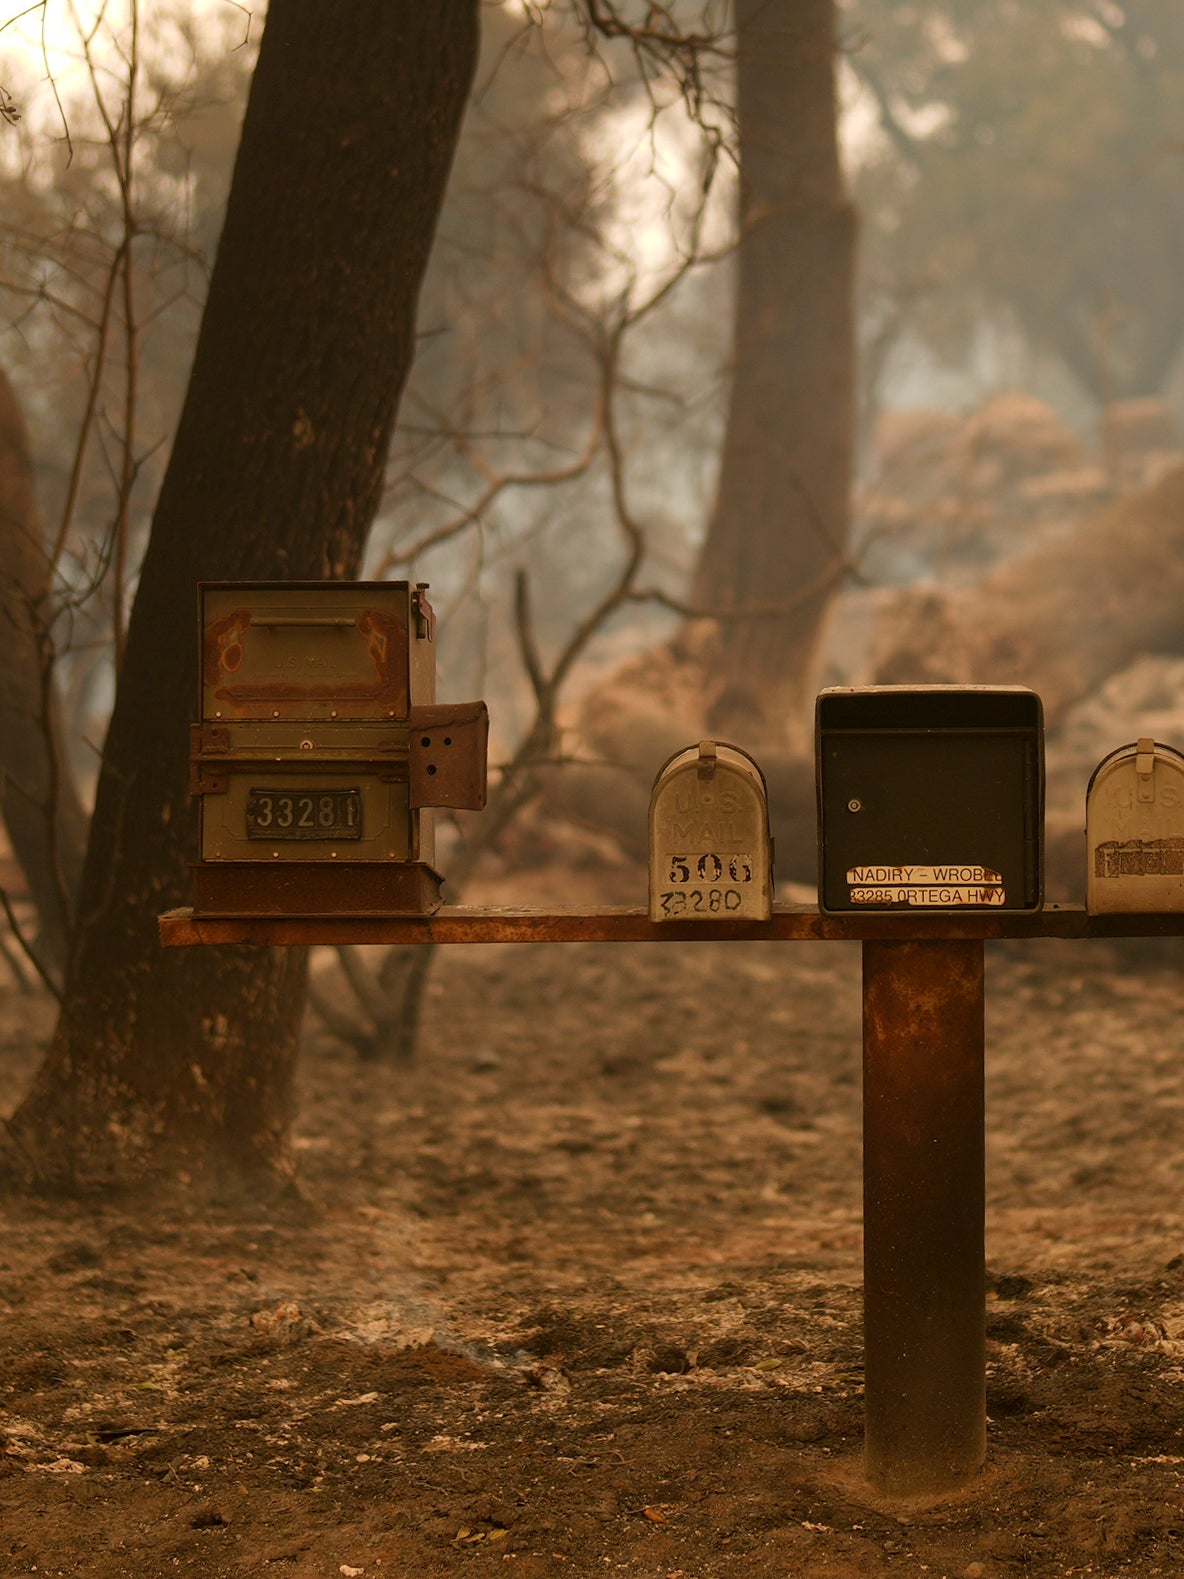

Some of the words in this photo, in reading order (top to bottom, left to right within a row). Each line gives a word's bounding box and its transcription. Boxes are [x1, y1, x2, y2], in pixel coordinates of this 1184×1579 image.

[256, 797, 356, 828] 33281
[672, 822, 744, 845] MAIL
[853, 868, 914, 882] NADIRY
[967, 889, 1006, 903] HWY
